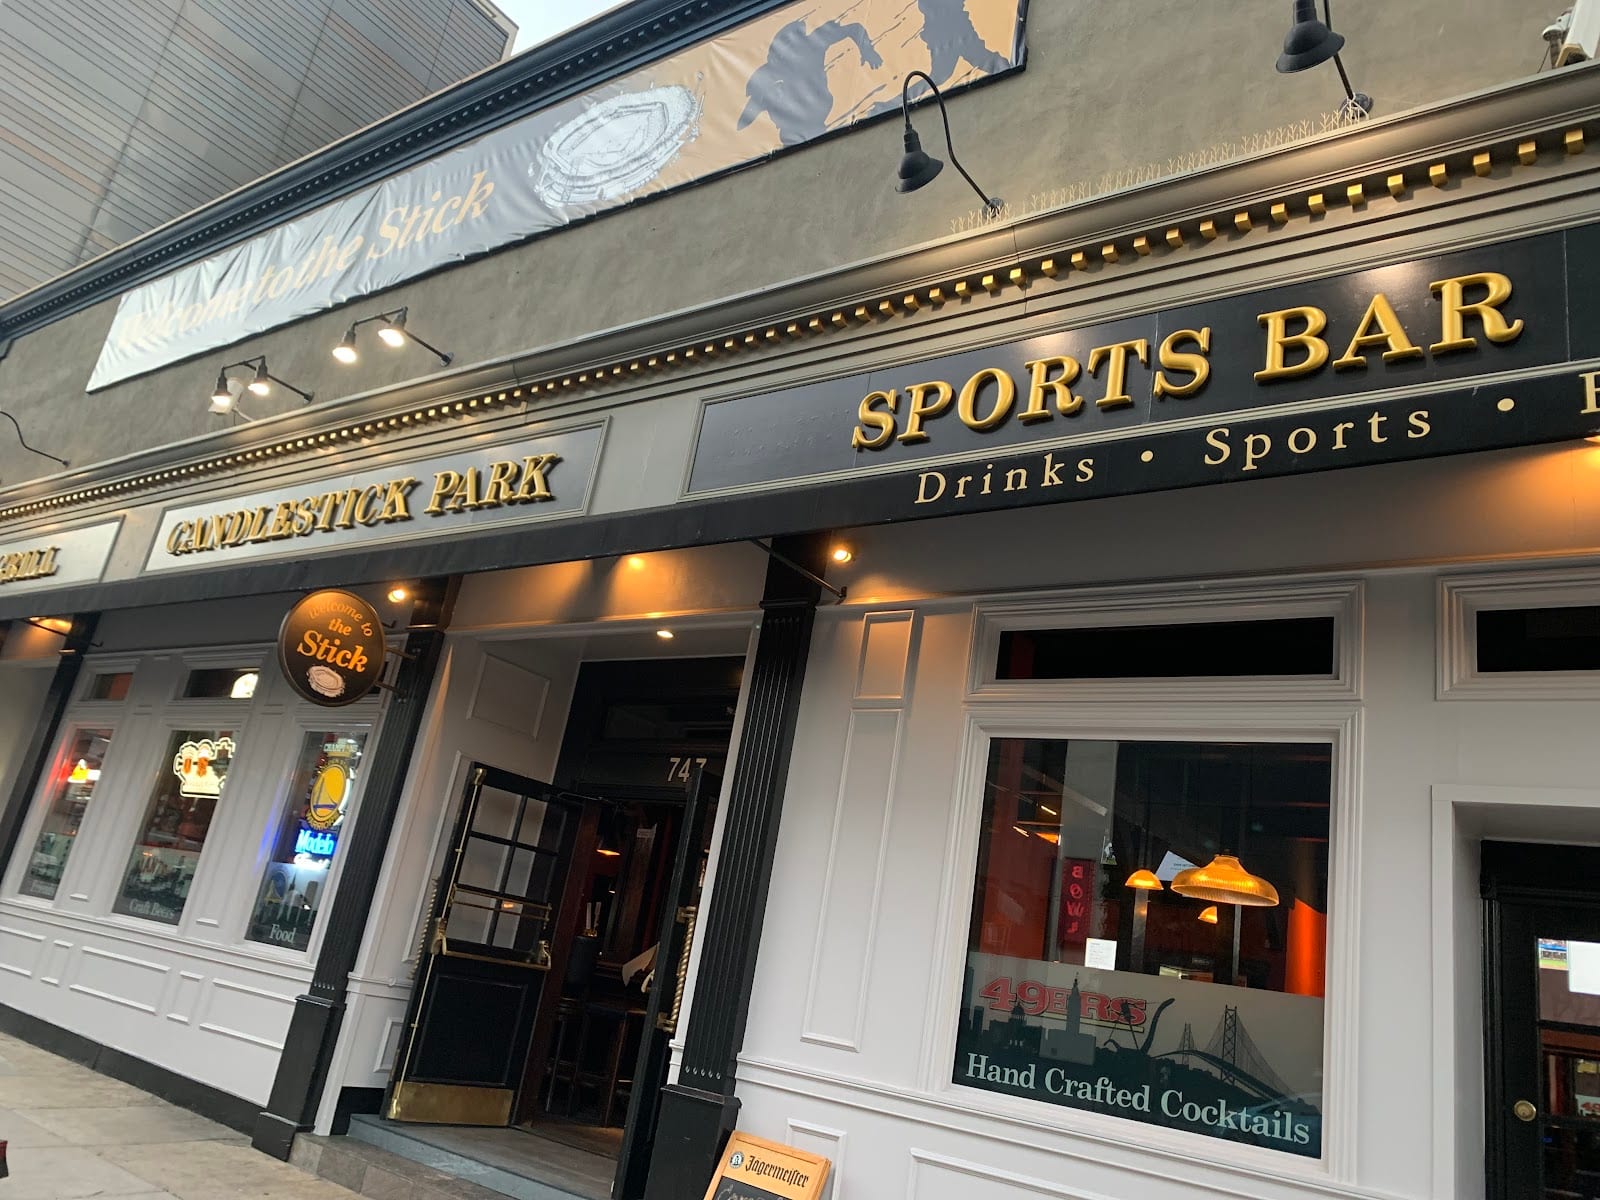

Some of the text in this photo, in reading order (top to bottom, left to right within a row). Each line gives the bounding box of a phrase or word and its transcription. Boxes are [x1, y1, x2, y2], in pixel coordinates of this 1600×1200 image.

[253, 265, 295, 305] to
[295, 235, 364, 289] the
[366, 169, 494, 260] Stick
[851, 271, 1525, 449] SPORTS BAR
[913, 409, 1431, 504] Drinks Sports
[165, 452, 559, 557] CANDLESTICK PARK
[296, 629, 368, 673] Stick
[308, 600, 374, 637] welcome to
[327, 617, 353, 636] the
[269, 923, 297, 944] Food
[979, 976, 1147, 1026] 49ERS
[965, 1053, 1311, 1145] Hand Crafted Cocktails
